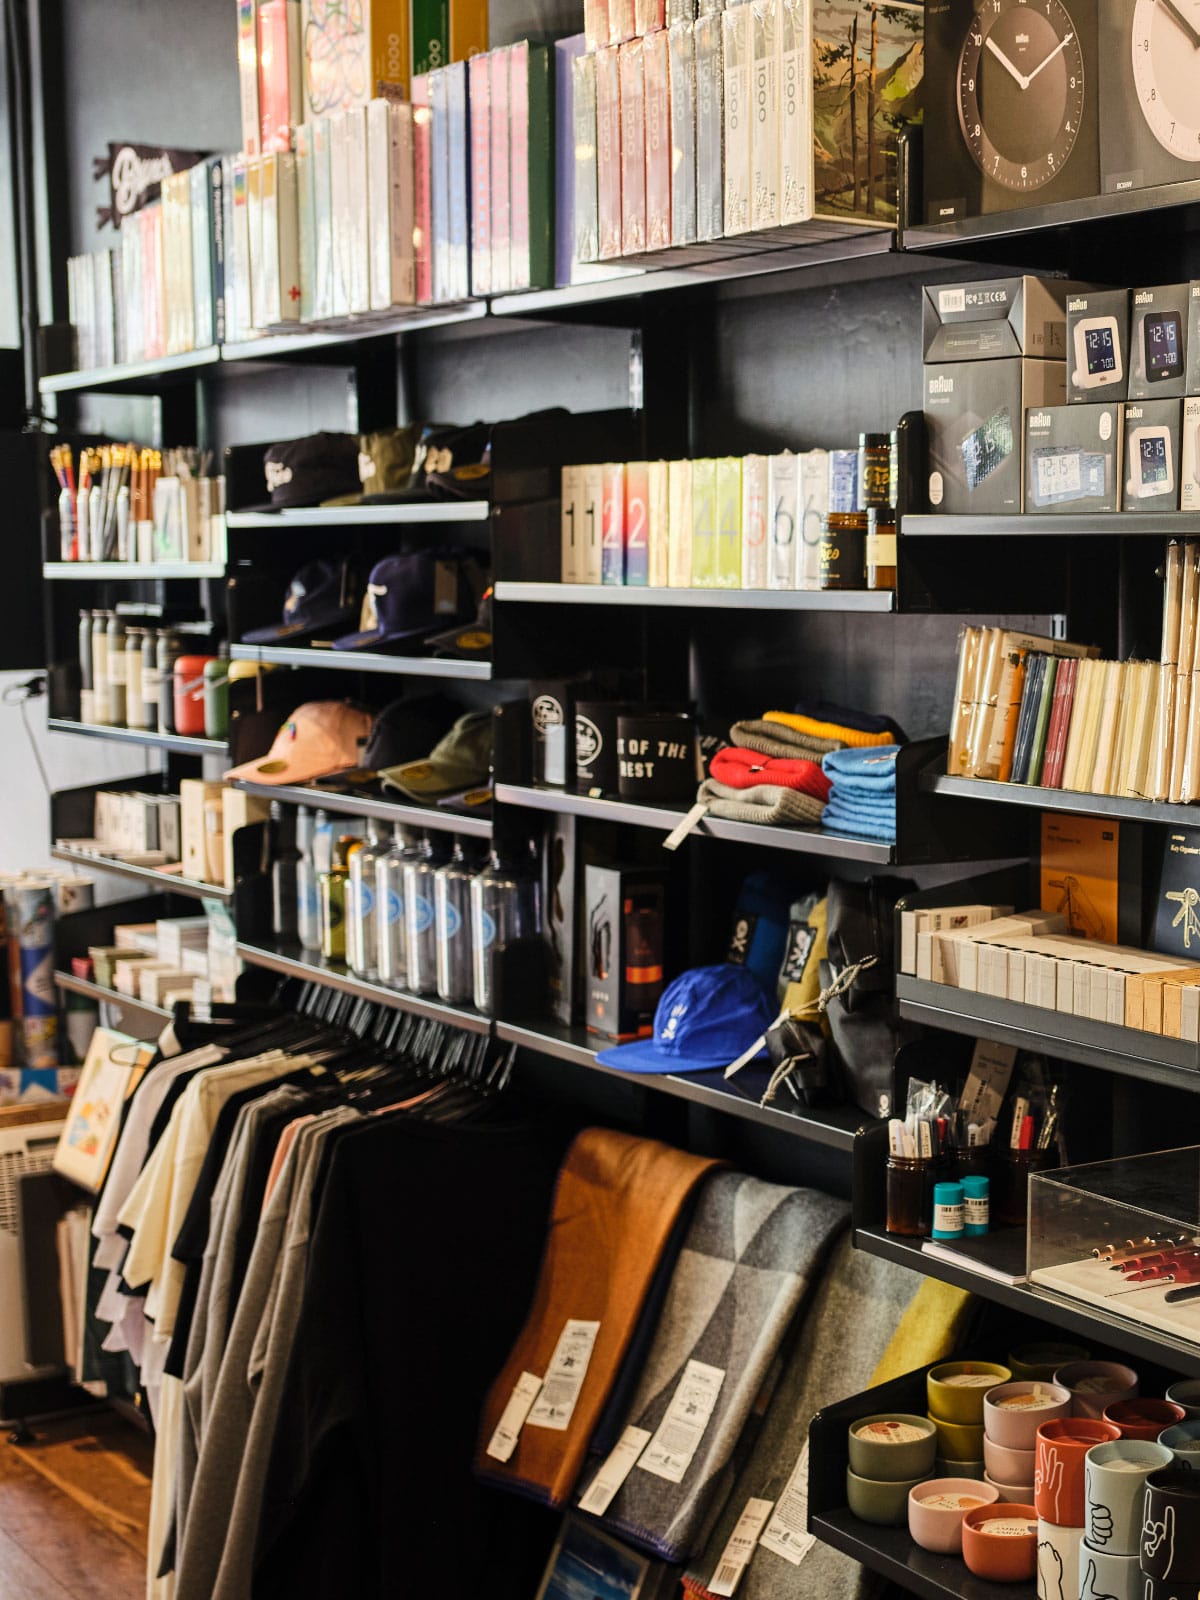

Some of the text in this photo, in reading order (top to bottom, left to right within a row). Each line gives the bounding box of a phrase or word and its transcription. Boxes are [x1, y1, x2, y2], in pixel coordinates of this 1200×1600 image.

[974, 34, 982, 47] 10
[1143, 39, 1149, 52] 9
[786, 57, 796, 116] 1000
[968, 79, 975, 92] 9
[1070, 77, 1076, 89] 3
[757, 65, 767, 123] 1000
[1150, 88, 1157, 101] 8
[730, 74, 739, 130] 1000
[974, 124, 981, 137] 8
[1065, 120, 1071, 132] 4
[1170, 122, 1176, 134] 7
[994, 155, 1000, 168] 7
[1047, 153, 1054, 165] 5
[1021, 166, 1028, 178] 6
[1135, 291, 1154, 305] BRAUN
[1068, 299, 1088, 312] BRAUN
[929, 376, 954, 394] BRAUN
[1029, 412, 1051, 428] BRAUN
[1125, 407, 1143, 419] BRAUN
[565, 502, 575, 547] 1
[586, 502, 595, 547] 1
[628, 497, 646, 549] 2
[694, 498, 714, 548] 4
[718, 498, 738, 548] 4
[774, 495, 794, 546] 6
[802, 494, 822, 547] 6
[628, 739, 649, 756] OF
[658, 741, 687, 760] THE
